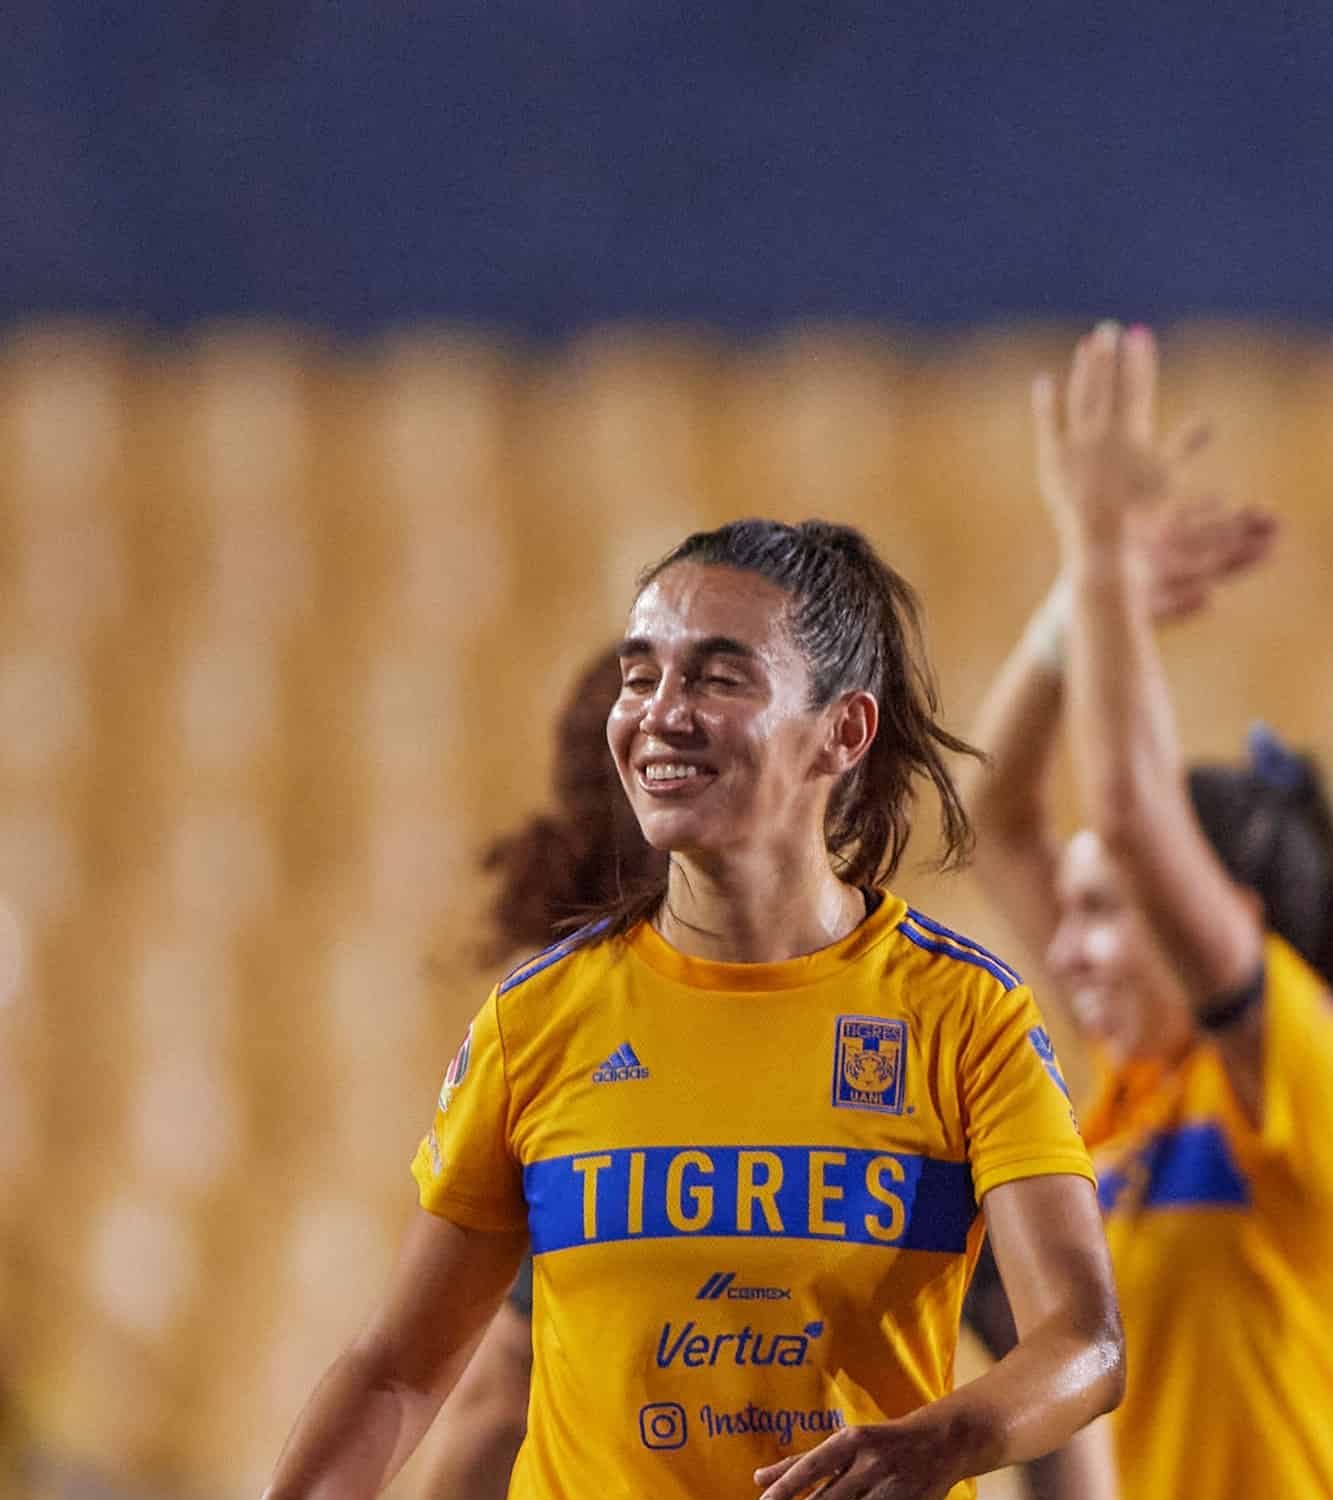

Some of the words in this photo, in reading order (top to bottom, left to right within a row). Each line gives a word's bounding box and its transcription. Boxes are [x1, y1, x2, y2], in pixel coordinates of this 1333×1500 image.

[592, 1065, 650, 1083] adidas
[572, 1150, 907, 1242] TIGRES
[656, 1321, 811, 1369] Vertua
